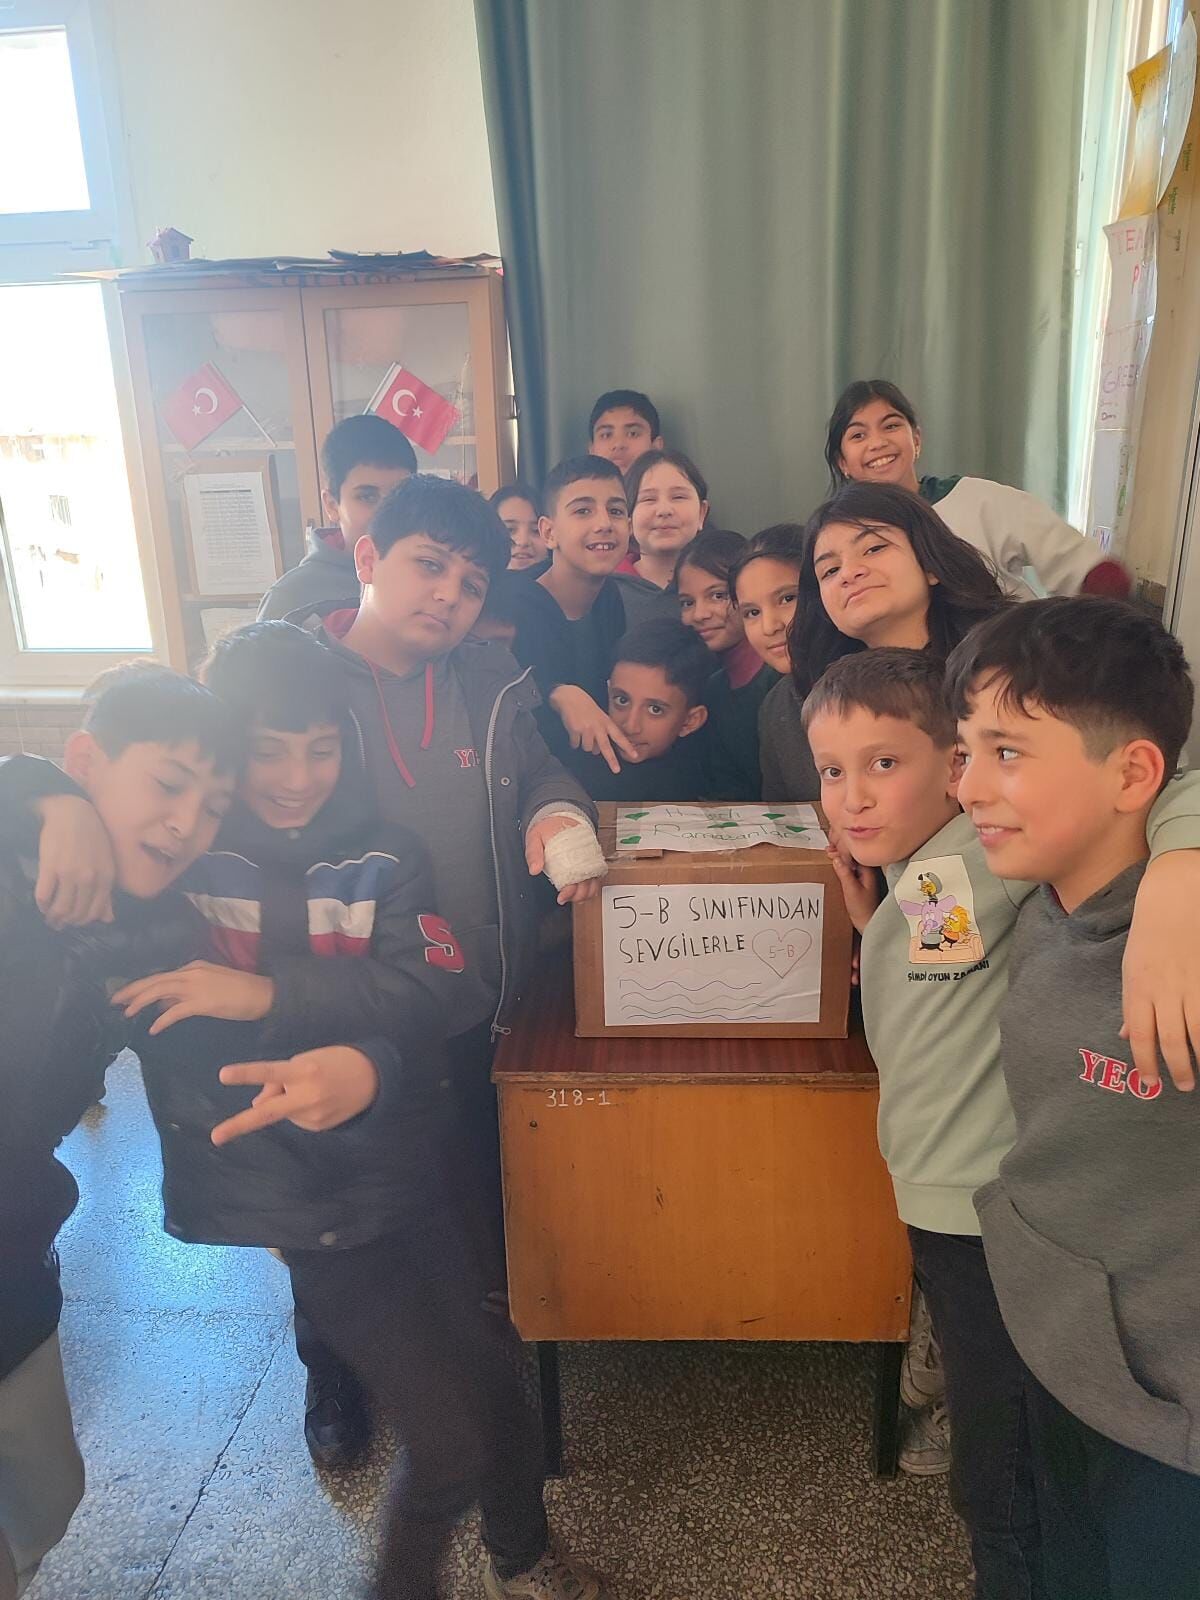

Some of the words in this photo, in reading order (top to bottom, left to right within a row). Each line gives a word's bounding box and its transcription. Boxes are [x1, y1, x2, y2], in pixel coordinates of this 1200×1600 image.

[613, 895, 670, 929] 5-B
[688, 895, 820, 922] SINIFINDAN
[619, 932, 746, 964] SEVGİLERLE
[768, 944, 796, 959] 5-B
[927, 972, 951, 981] OYUN
[545, 1088, 611, 1108] 318-1
